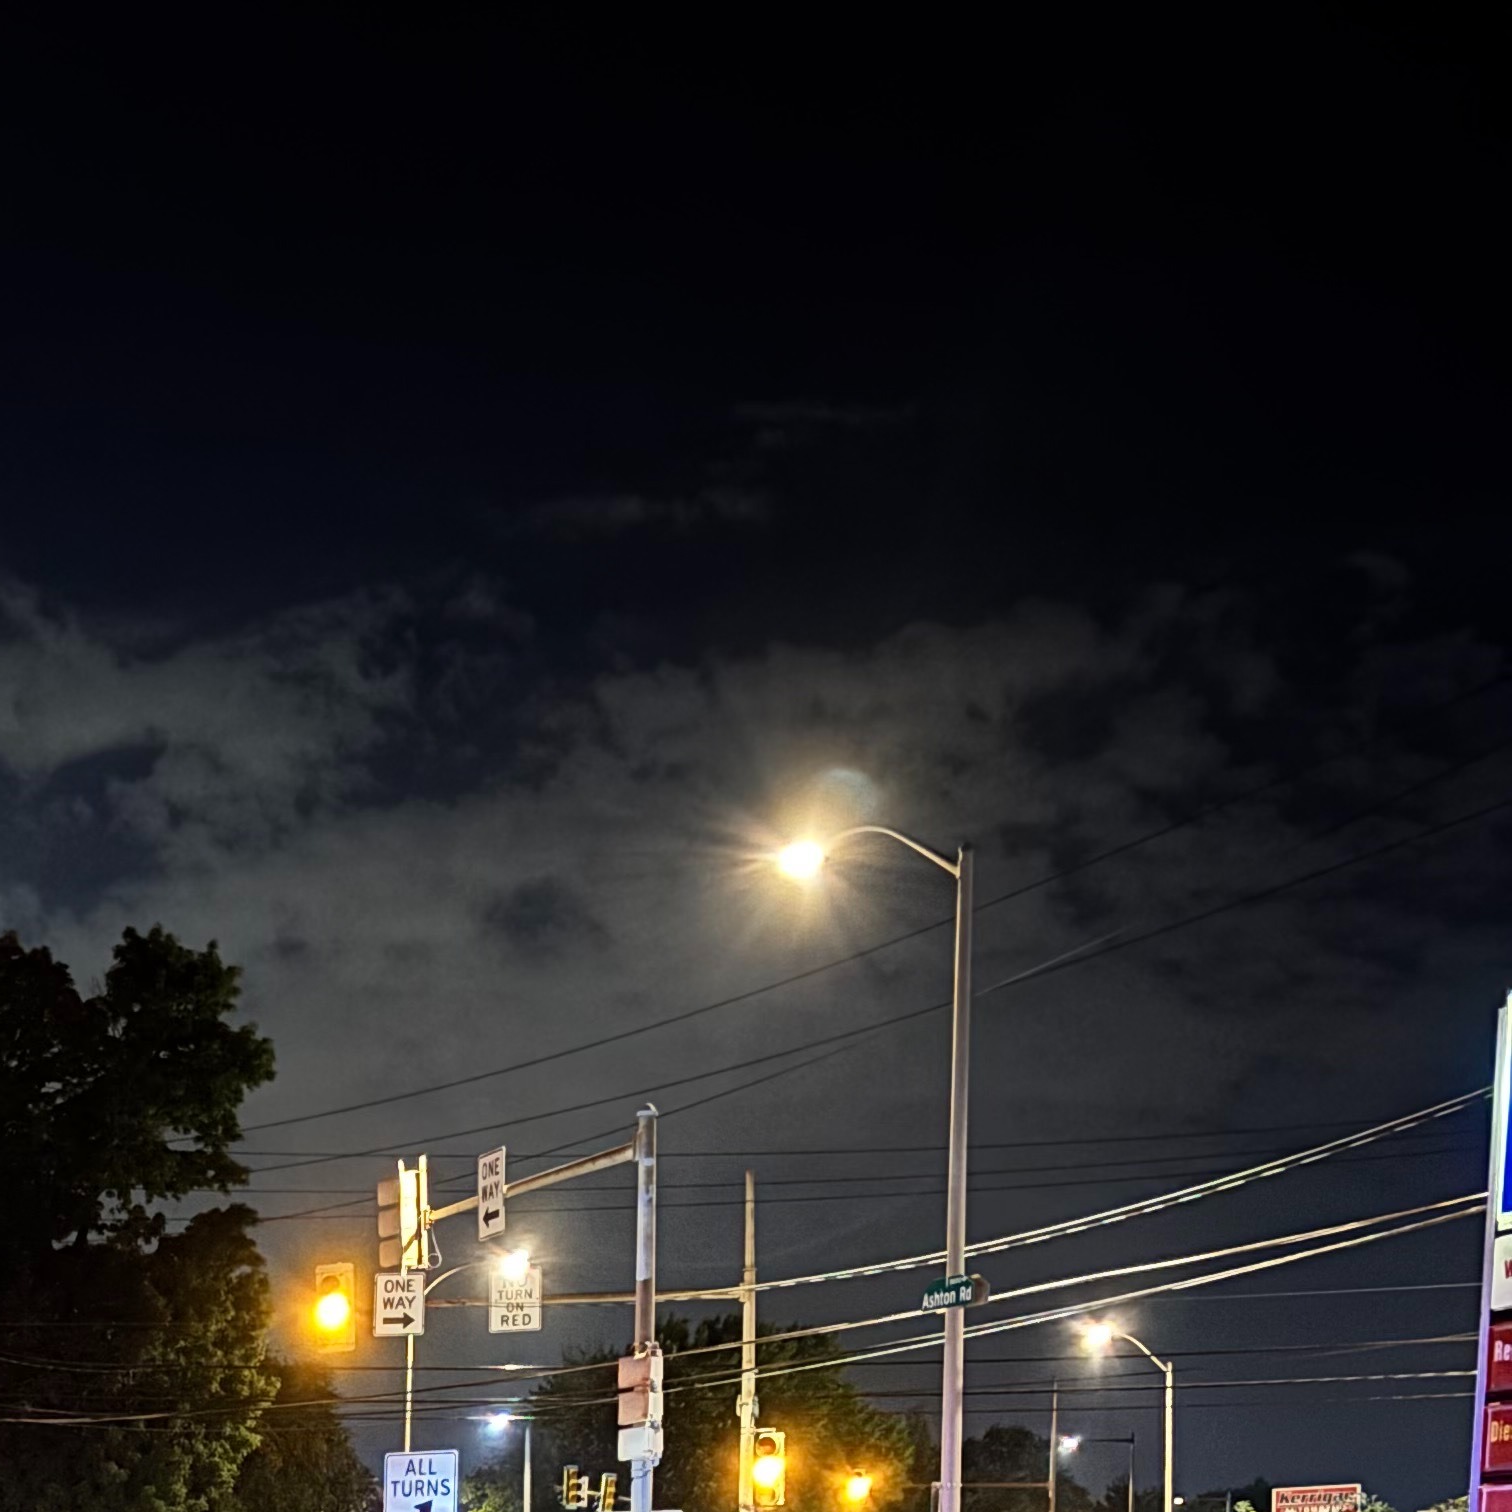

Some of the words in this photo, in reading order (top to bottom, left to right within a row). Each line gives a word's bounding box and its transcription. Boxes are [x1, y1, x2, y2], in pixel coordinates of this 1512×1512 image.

[482, 1158, 500, 1179] ONE
[482, 1182, 501, 1203] WAY
[384, 1279, 415, 1293] ONE
[497, 1289, 533, 1301] TURN
[383, 1296, 416, 1310] WAY
[506, 1302, 524, 1312] ON
[922, 1290, 957, 1310] Ashton
[959, 1286, 972, 1302] Rd
[500, 1313, 532, 1327] RED
[1490, 1421, 1512, 1442] Die
[405, 1458, 437, 1476] ALL
[391, 1478, 451, 1498] TURNS
